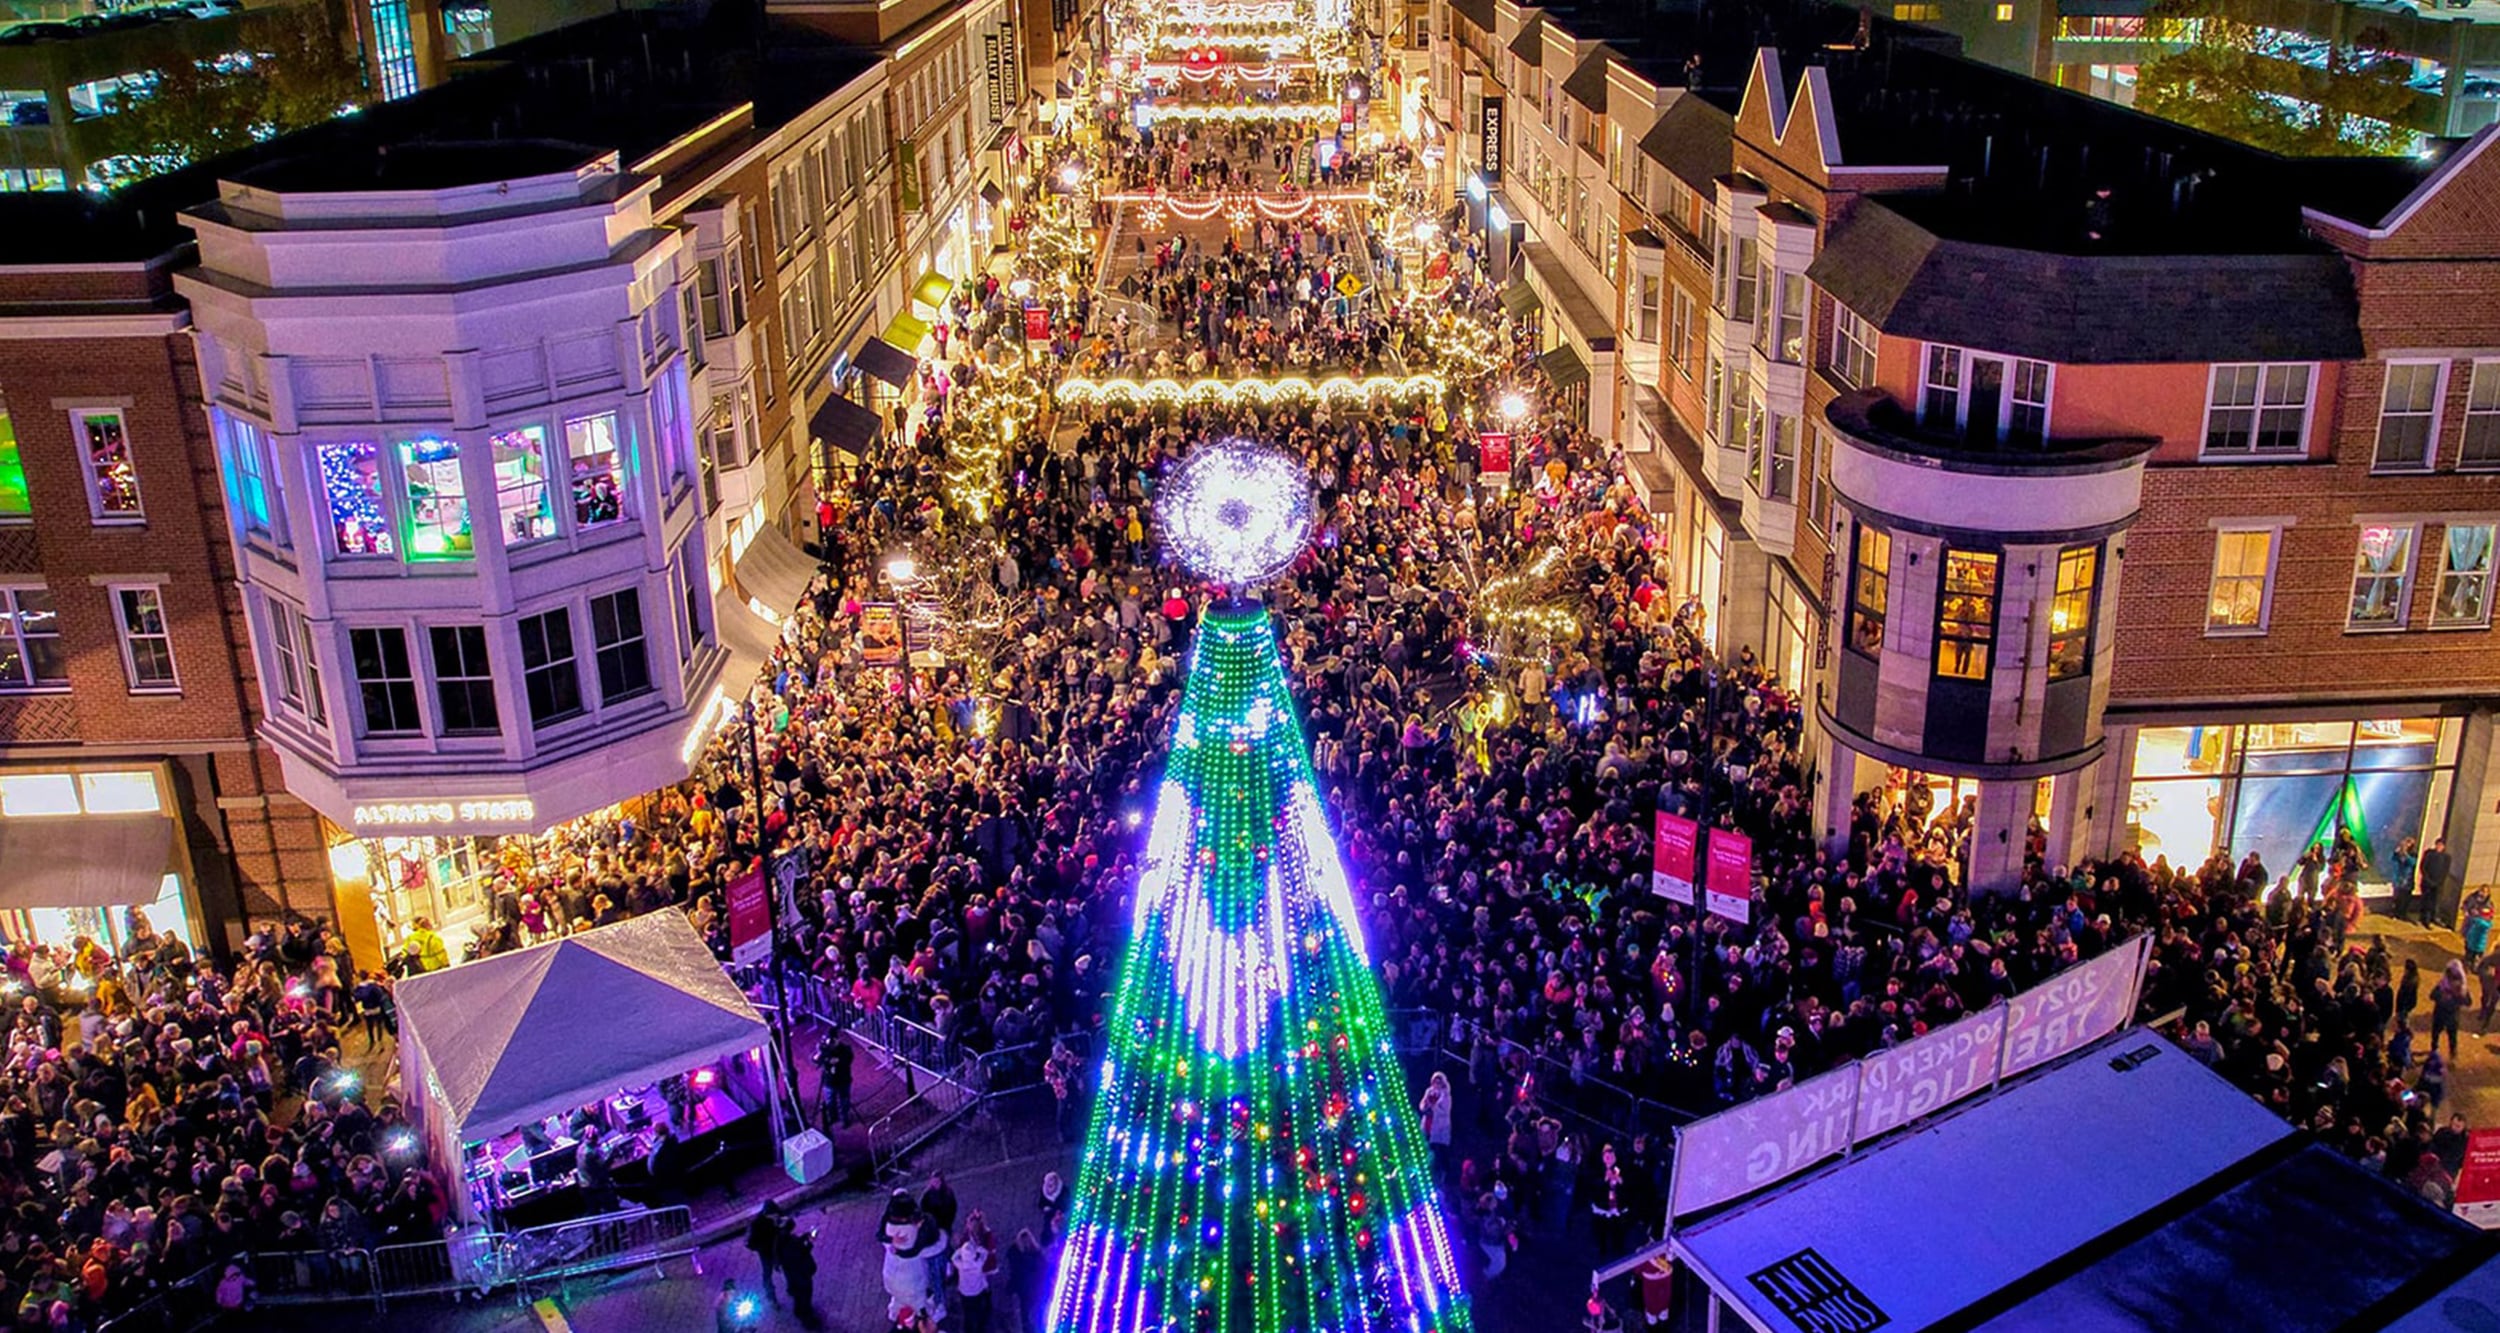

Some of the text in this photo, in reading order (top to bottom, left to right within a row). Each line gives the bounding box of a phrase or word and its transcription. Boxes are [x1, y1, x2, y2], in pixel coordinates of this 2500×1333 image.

[987, 40, 1001, 120] RALLY HOUSE
[1002, 26, 1015, 103] RALLY HOUSE
[1486, 108, 1498, 171] EXPRESS
[459, 800, 535, 821] STATE
[1756, 1254, 1842, 1311] LINE
